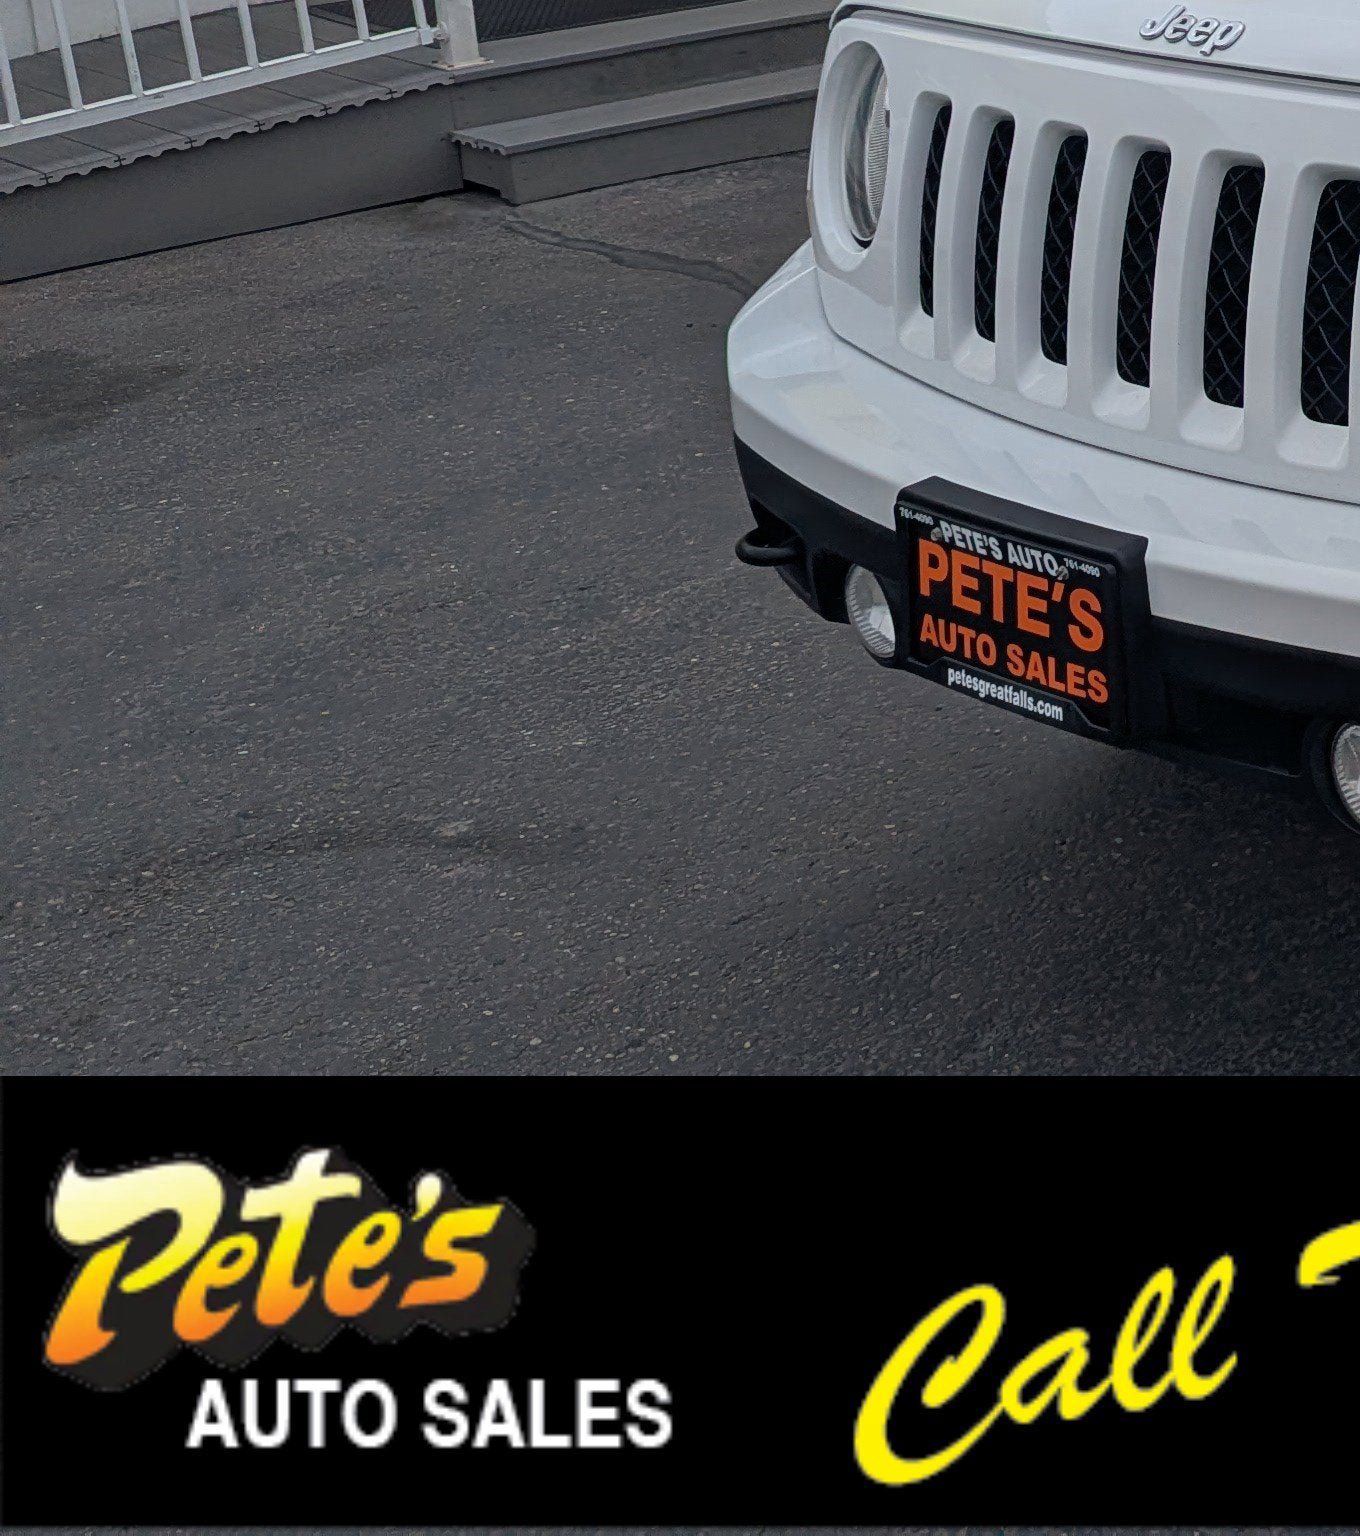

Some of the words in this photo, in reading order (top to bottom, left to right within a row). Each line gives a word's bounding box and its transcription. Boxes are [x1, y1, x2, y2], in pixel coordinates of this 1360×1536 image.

[1139, 4, 1246, 56] Jeep
[899, 506, 934, 526] 761-4090
[940, 520, 1003, 561] PETE'S
[1007, 542, 1060, 577] AUTO
[1063, 557, 1101, 579] 761-4090
[918, 537, 1105, 652] PETE'S
[919, 613, 998, 667] AUTO
[1006, 643, 1110, 704] SALES
[947, 667, 1065, 722] petesgreatfalls.com
